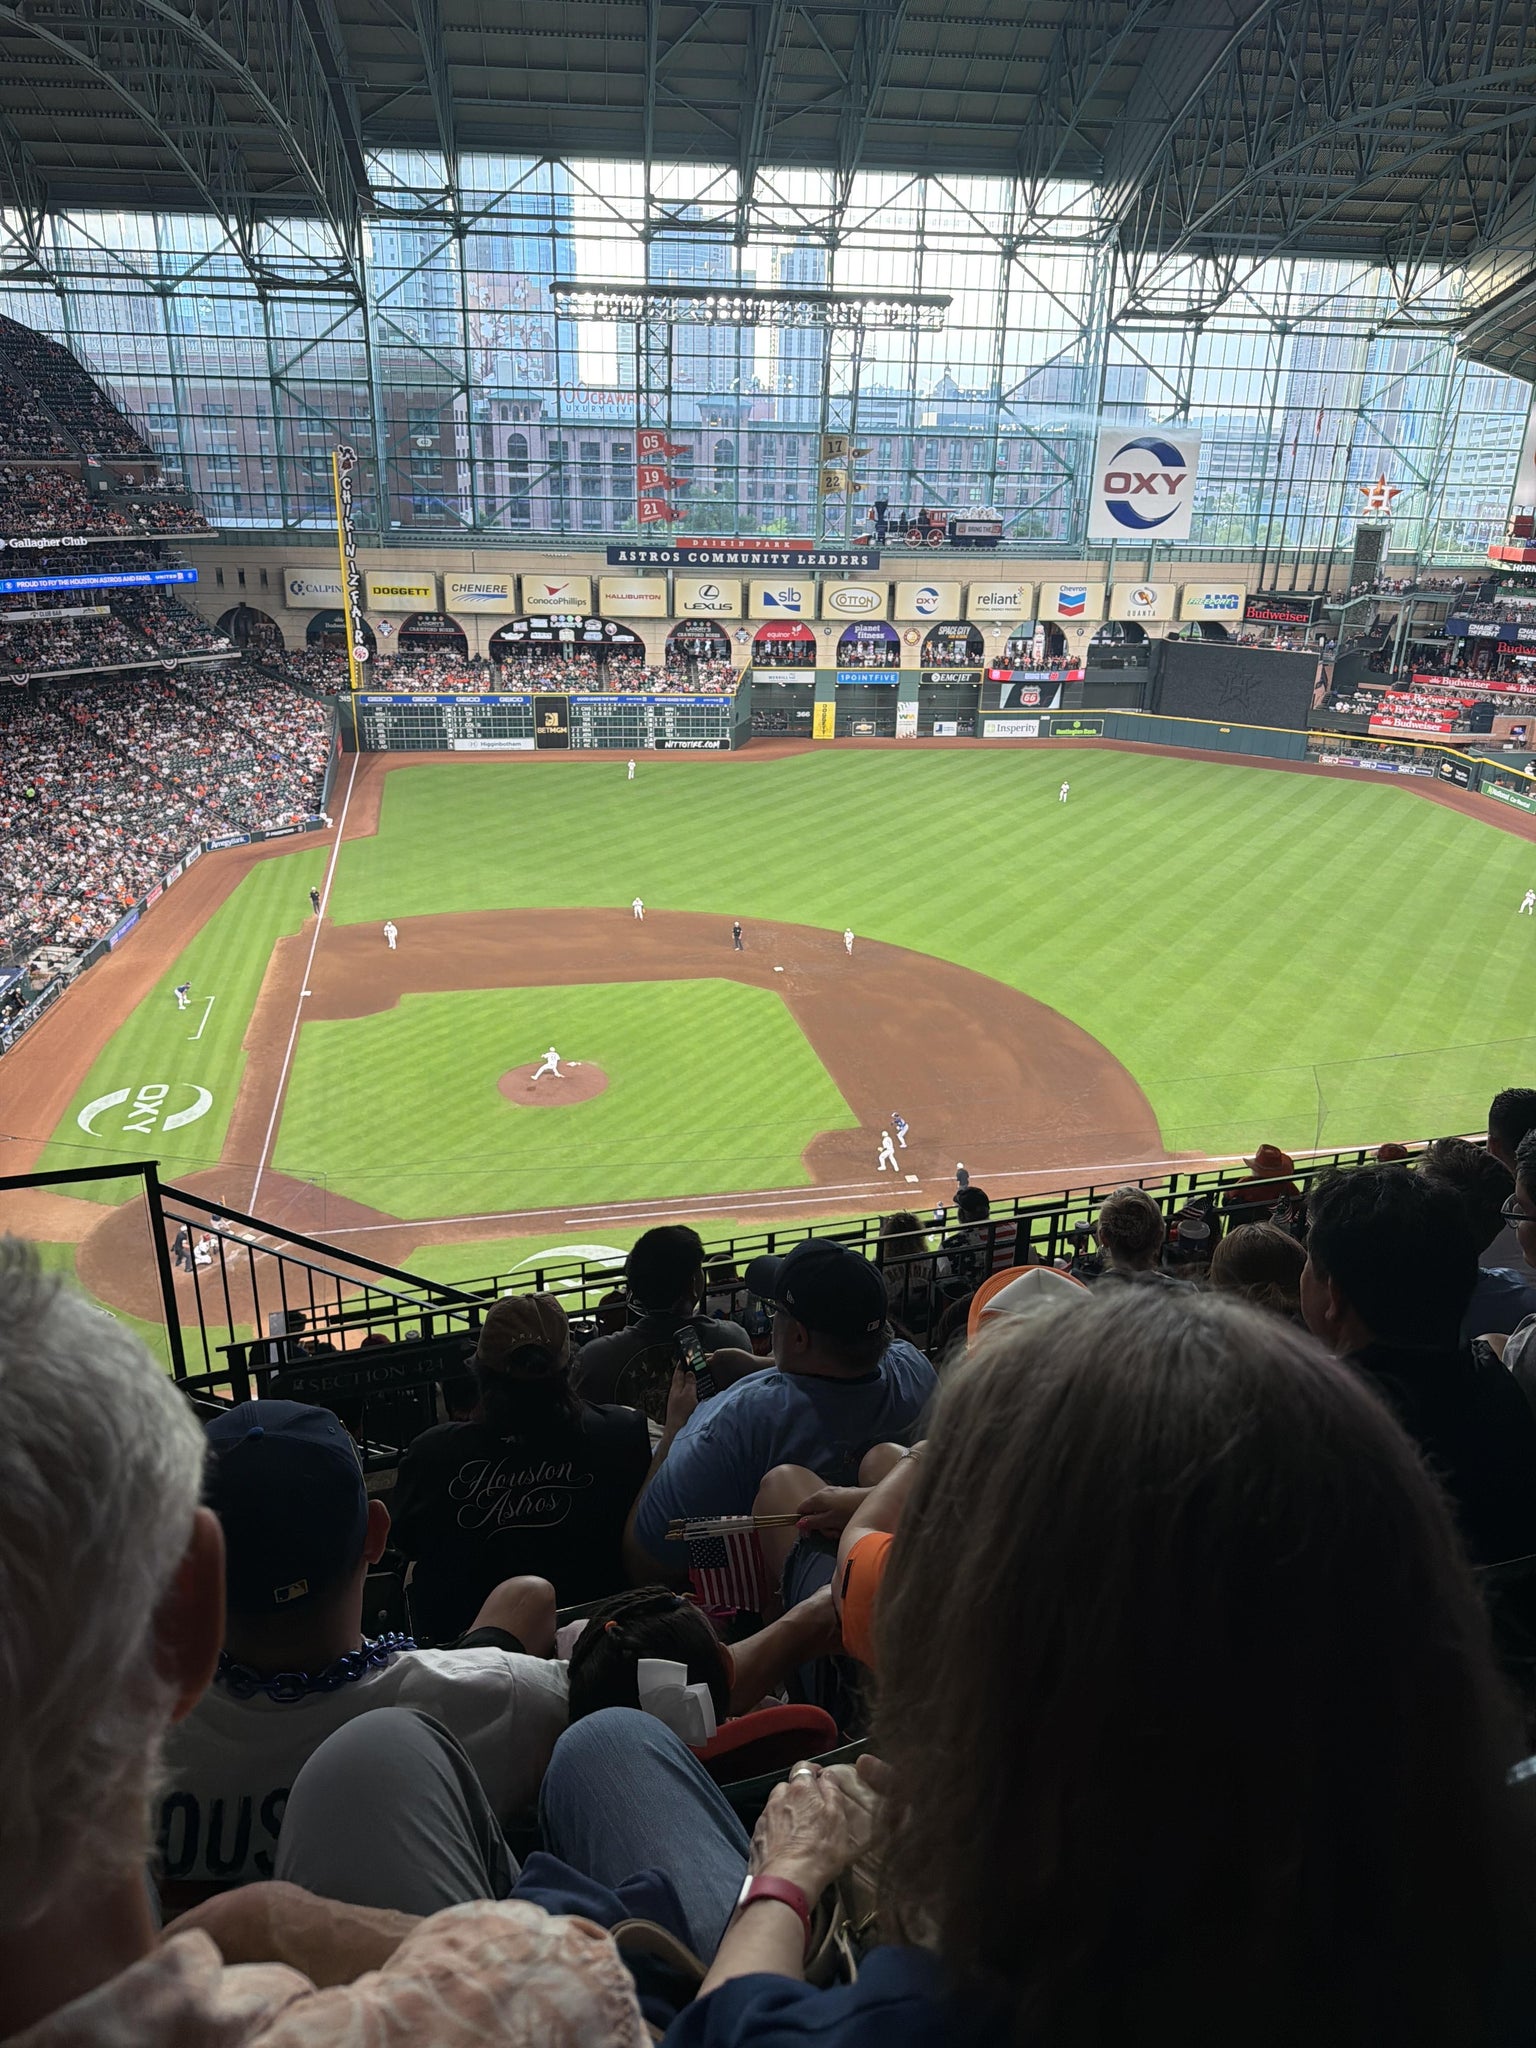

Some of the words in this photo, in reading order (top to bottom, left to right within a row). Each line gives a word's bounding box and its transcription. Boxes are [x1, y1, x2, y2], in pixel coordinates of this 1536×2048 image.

[643, 436, 659, 449] 05
[828, 440, 842, 453] 17
[643, 470, 660, 484] 19
[825, 475, 840, 488] 22
[1103, 472, 1188, 495] OXY
[643, 502, 658, 515] 21
[341, 477, 356, 558] CHIKIN
[9, 538, 60, 549] Gallagher
[62, 537, 88, 546] Club
[692, 539, 745, 547] DAIKIN
[618, 551, 680, 562] ASTROS
[688, 552, 790, 564] COMMUNITY
[797, 554, 869, 566] LEADERS
[347, 560, 360, 587] IZ
[306, 584, 343, 593] CALPIN
[373, 587, 430, 595] DOGGETT
[451, 583, 508, 594] CHENIERE
[779, 587, 801, 602] slb
[527, 595, 587, 606] ConocoPhillips
[835, 593, 874, 607] COTTON
[978, 593, 1017, 604] reliant
[1204, 594, 1239, 610] LNG
[683, 602, 733, 611] LEXUS
[348, 590, 364, 644] FAIR
[1246, 606, 1309, 622] Budweiser
[767, 631, 790, 639] equinor
[854, 624, 880, 633] planet
[938, 626, 956, 635] SPACE
[956, 626, 972, 635] CITY
[840, 673, 896, 682] 1POINTFIVE
[1441, 677, 1491, 689] Budweiser
[1024, 693, 1037, 702] 66
[996, 723, 1036, 734] Insperity
[1393, 718, 1442, 731] Budweiser
[664, 740, 720, 749] NITTOTIRE.COM
[122, 1084, 170, 1134] OXY
[309, 1365, 406, 1392] SECTION
[448, 1455, 592, 1501] Houston
[457, 1485, 573, 1531] Astros
